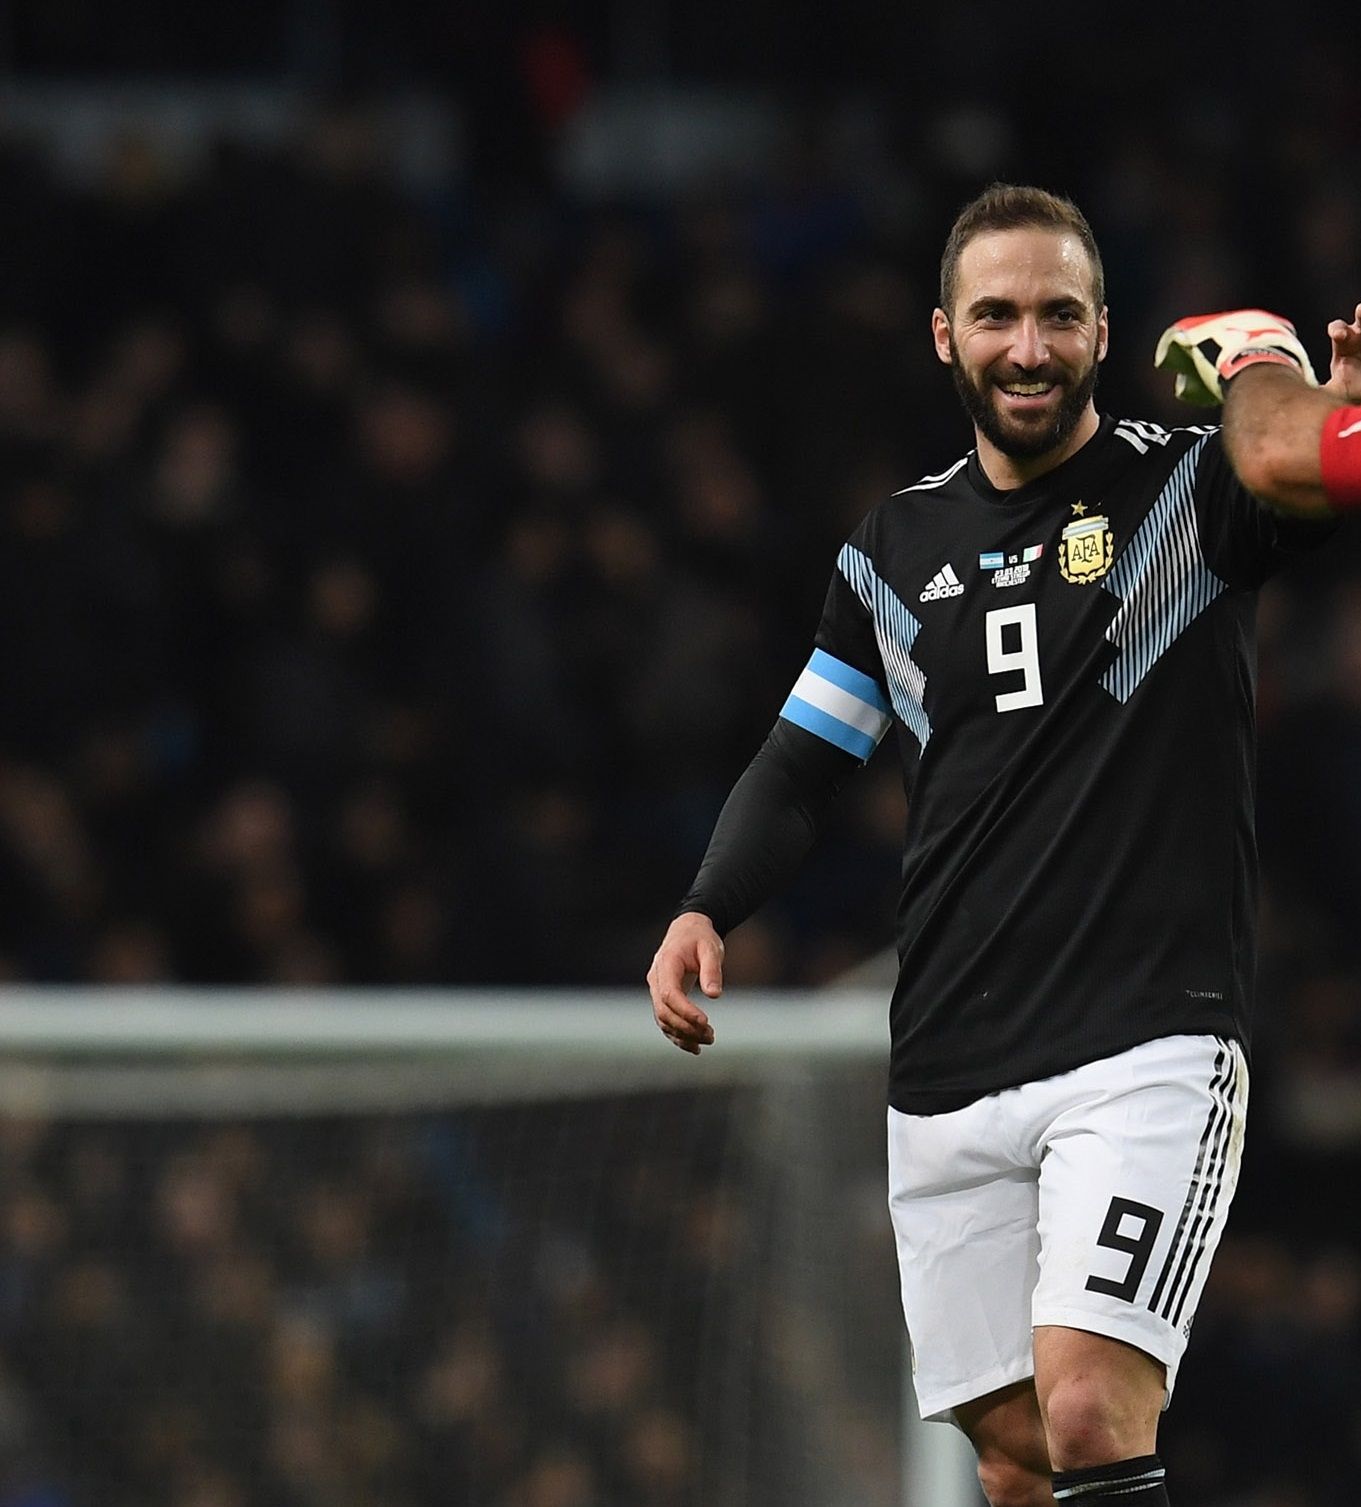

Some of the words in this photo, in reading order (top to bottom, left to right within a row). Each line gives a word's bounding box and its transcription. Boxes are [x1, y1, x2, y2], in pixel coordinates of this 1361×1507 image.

[1071, 534, 1101, 563] AFA
[919, 583, 965, 602] adidas
[986, 603, 1044, 713] 9
[1085, 1196, 1165, 1304] 9
